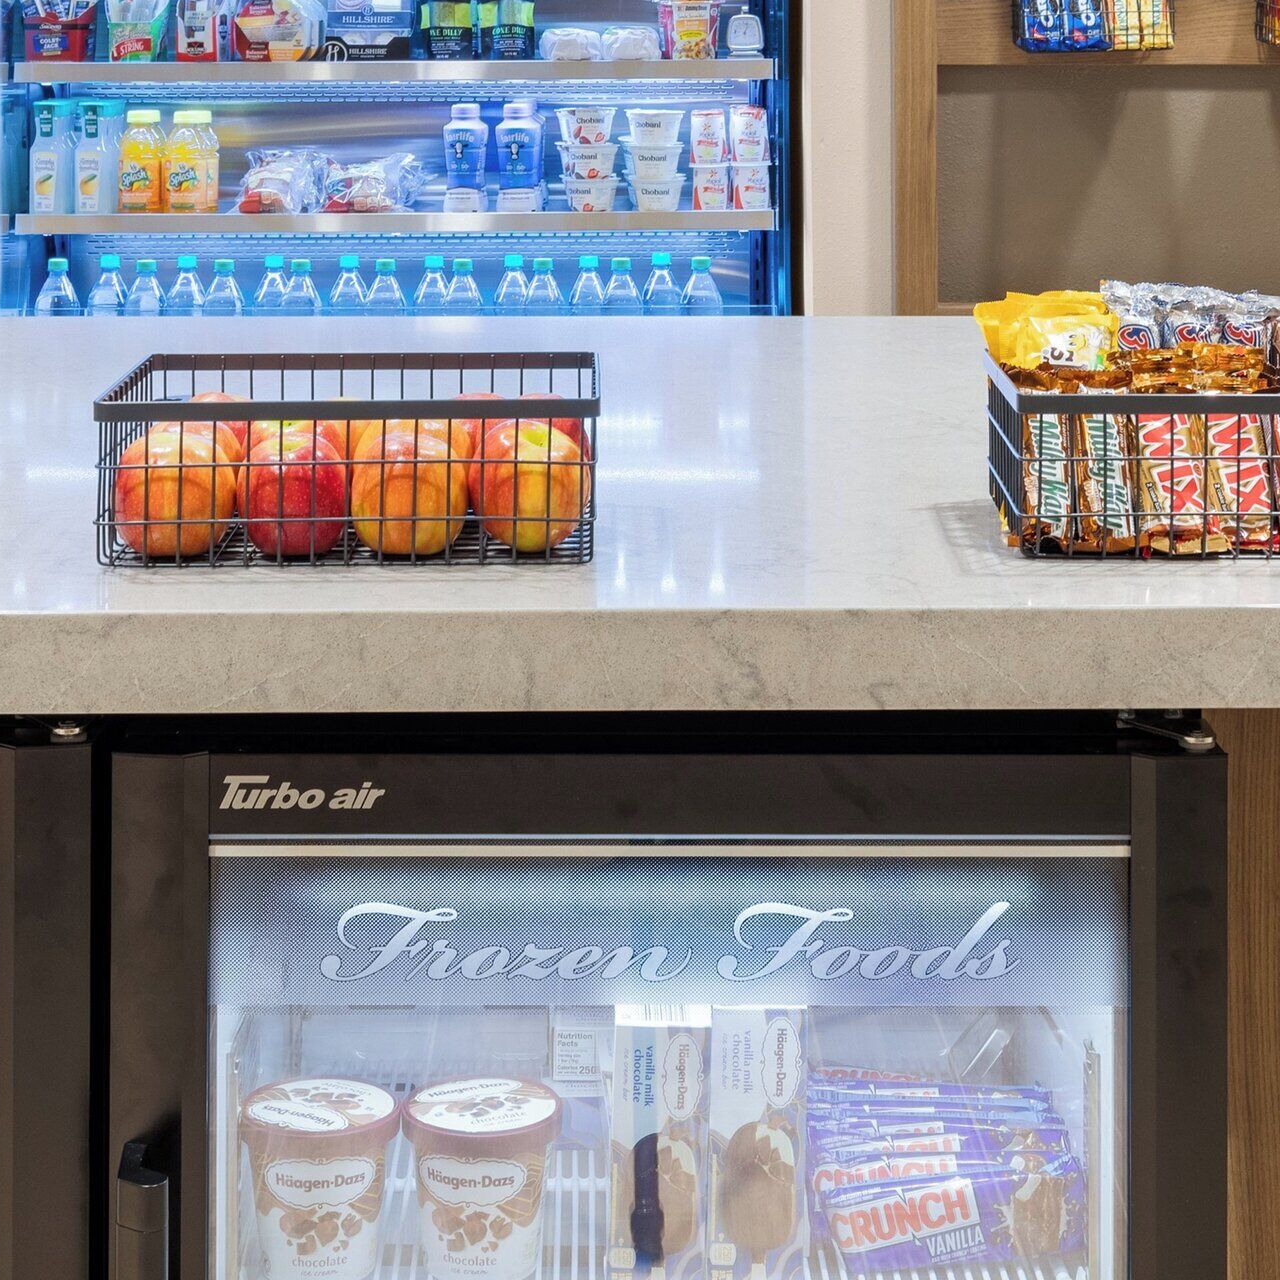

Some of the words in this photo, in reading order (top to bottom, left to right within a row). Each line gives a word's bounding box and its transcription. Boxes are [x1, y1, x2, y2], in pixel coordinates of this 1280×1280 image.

[120, 42, 145, 55] STRING
[122, 170, 148, 186] Splash
[170, 169, 196, 186] Splash
[1028, 417, 1064, 478] Milky
[1085, 417, 1122, 480] Milky
[1036, 479, 1070, 525] Way
[1095, 479, 1130, 532] Way
[219, 775, 325, 810] Turbo
[328, 782, 386, 810] air
[319, 902, 695, 982] Frozen
[717, 901, 1020, 982] Foods
[557, 1032, 593, 1041] Nutrition
[743, 1030, 752, 1065] vanilla
[633, 1048, 641, 1104] chocolate
[643, 1045, 653, 1081] vanilla
[674, 1043, 690, 1110] Häagen-Dazs
[732, 1033, 742, 1090] chocolate
[773, 1028, 787, 1098] Häagen-Dazs
[643, 1084, 653, 1107] milk
[743, 1068, 751, 1095] milk
[275, 1171, 366, 1193] Häagen-Dazs
[426, 1167, 516, 1190] Häagen-Dazs
[831, 1186, 970, 1248] CRUNCH
[926, 1225, 985, 1257] VANILLA
[291, 1253, 349, 1267] chocolate
[442, 1252, 498, 1266] chocolate
